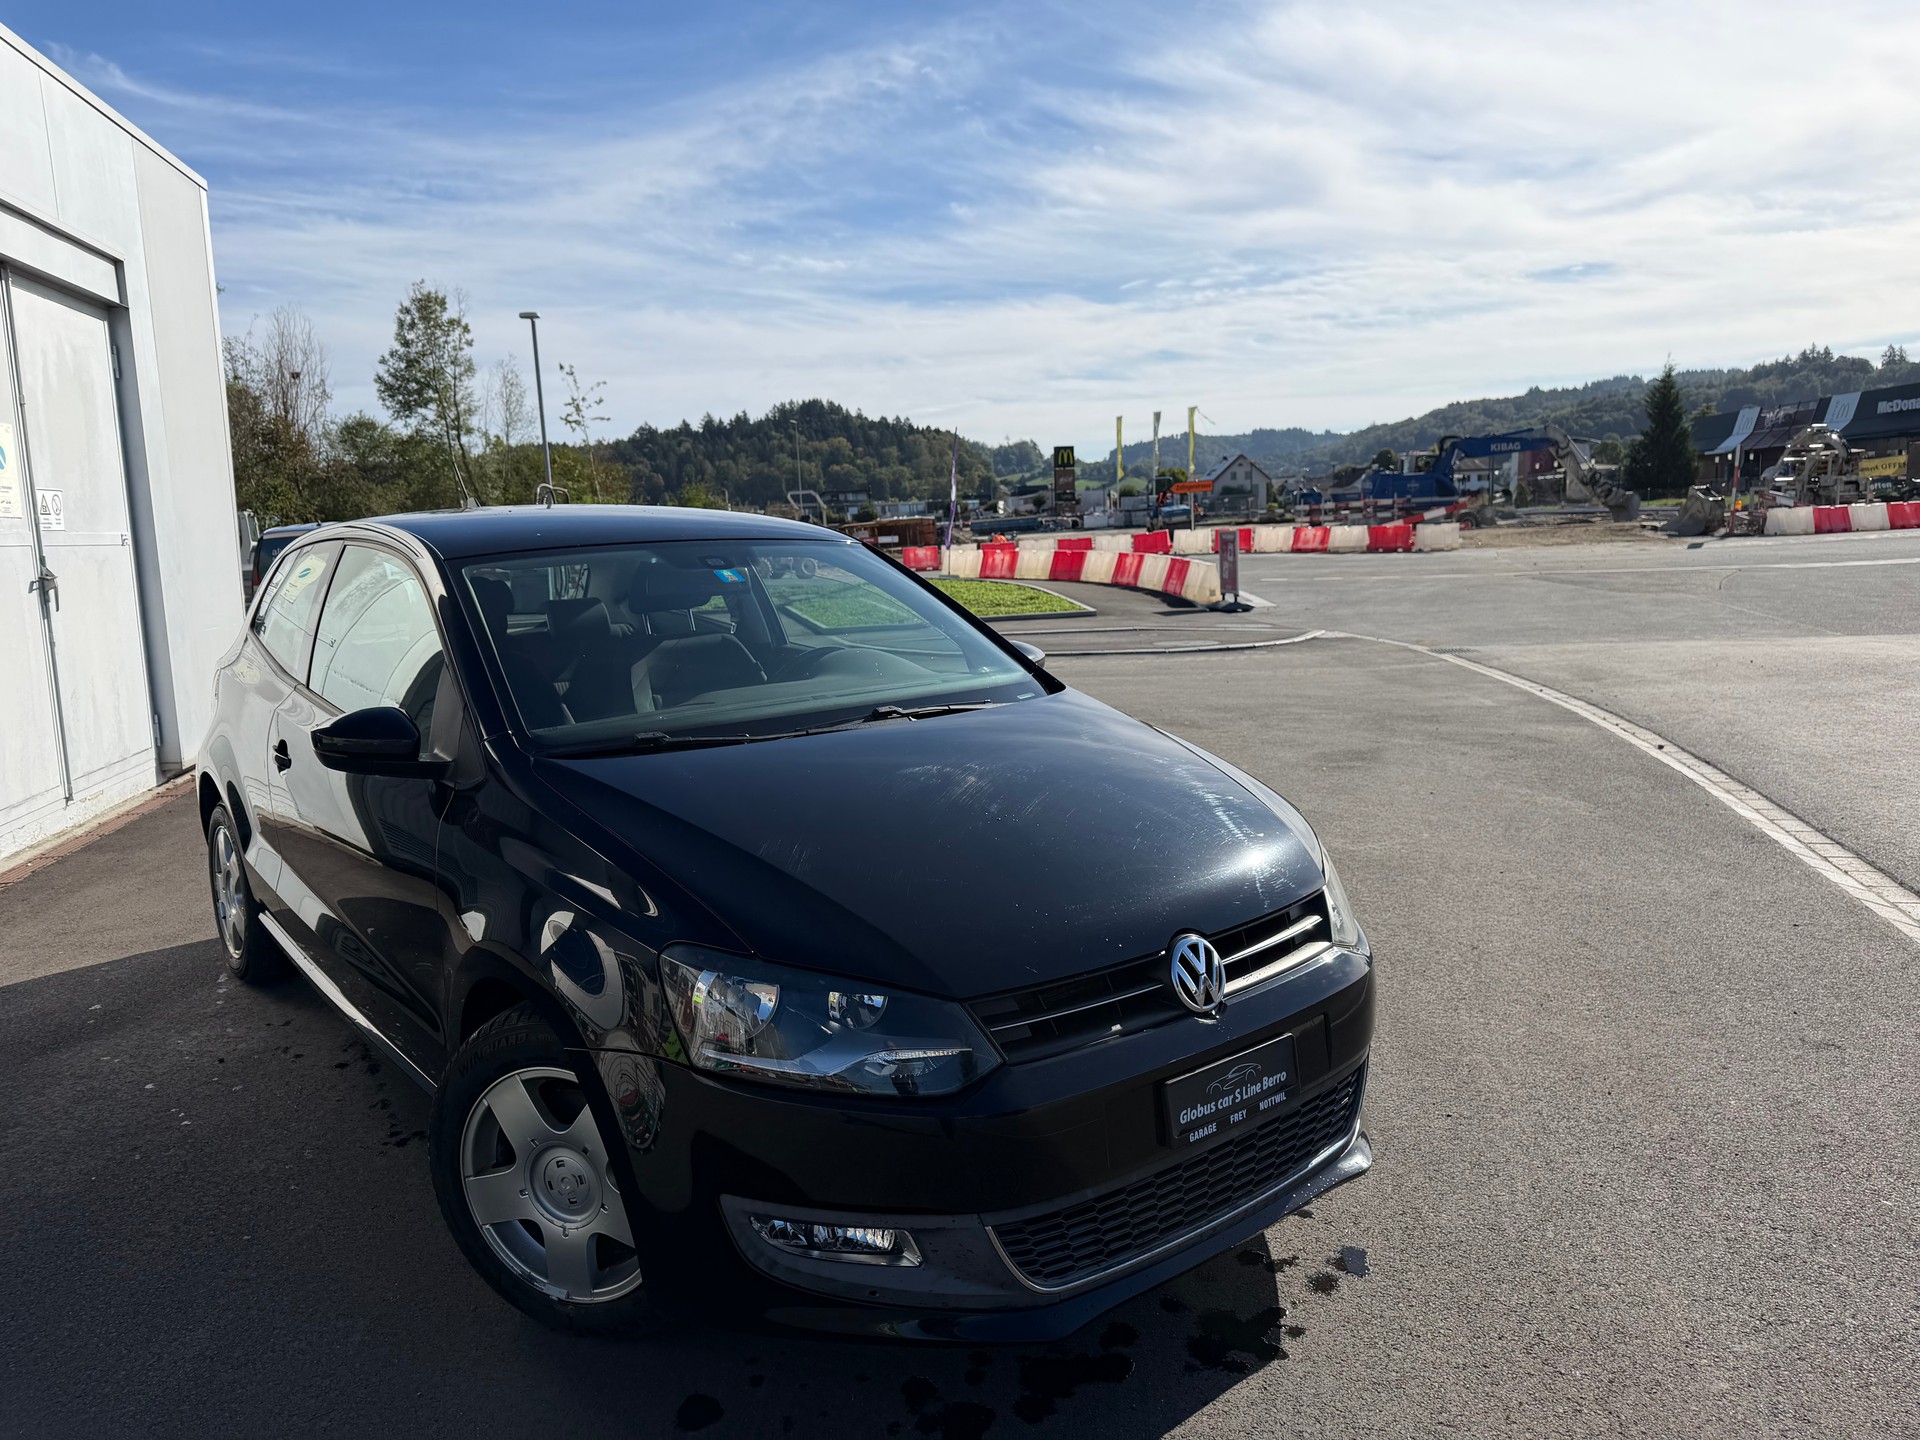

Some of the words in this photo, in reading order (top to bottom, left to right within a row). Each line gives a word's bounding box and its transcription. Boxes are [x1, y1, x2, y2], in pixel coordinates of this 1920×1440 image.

[1180, 1101, 1216, 1124] Globus
[1217, 1096, 1233, 1110] car
[1235, 1088, 1241, 1103] S
[1242, 1082, 1261, 1100] Line
[1262, 1071, 1287, 1090] Berro
[1189, 1123, 1217, 1142] GARAGE
[1230, 1109, 1247, 1124] FREY
[1259, 1092, 1286, 1111] NOTTWIL
